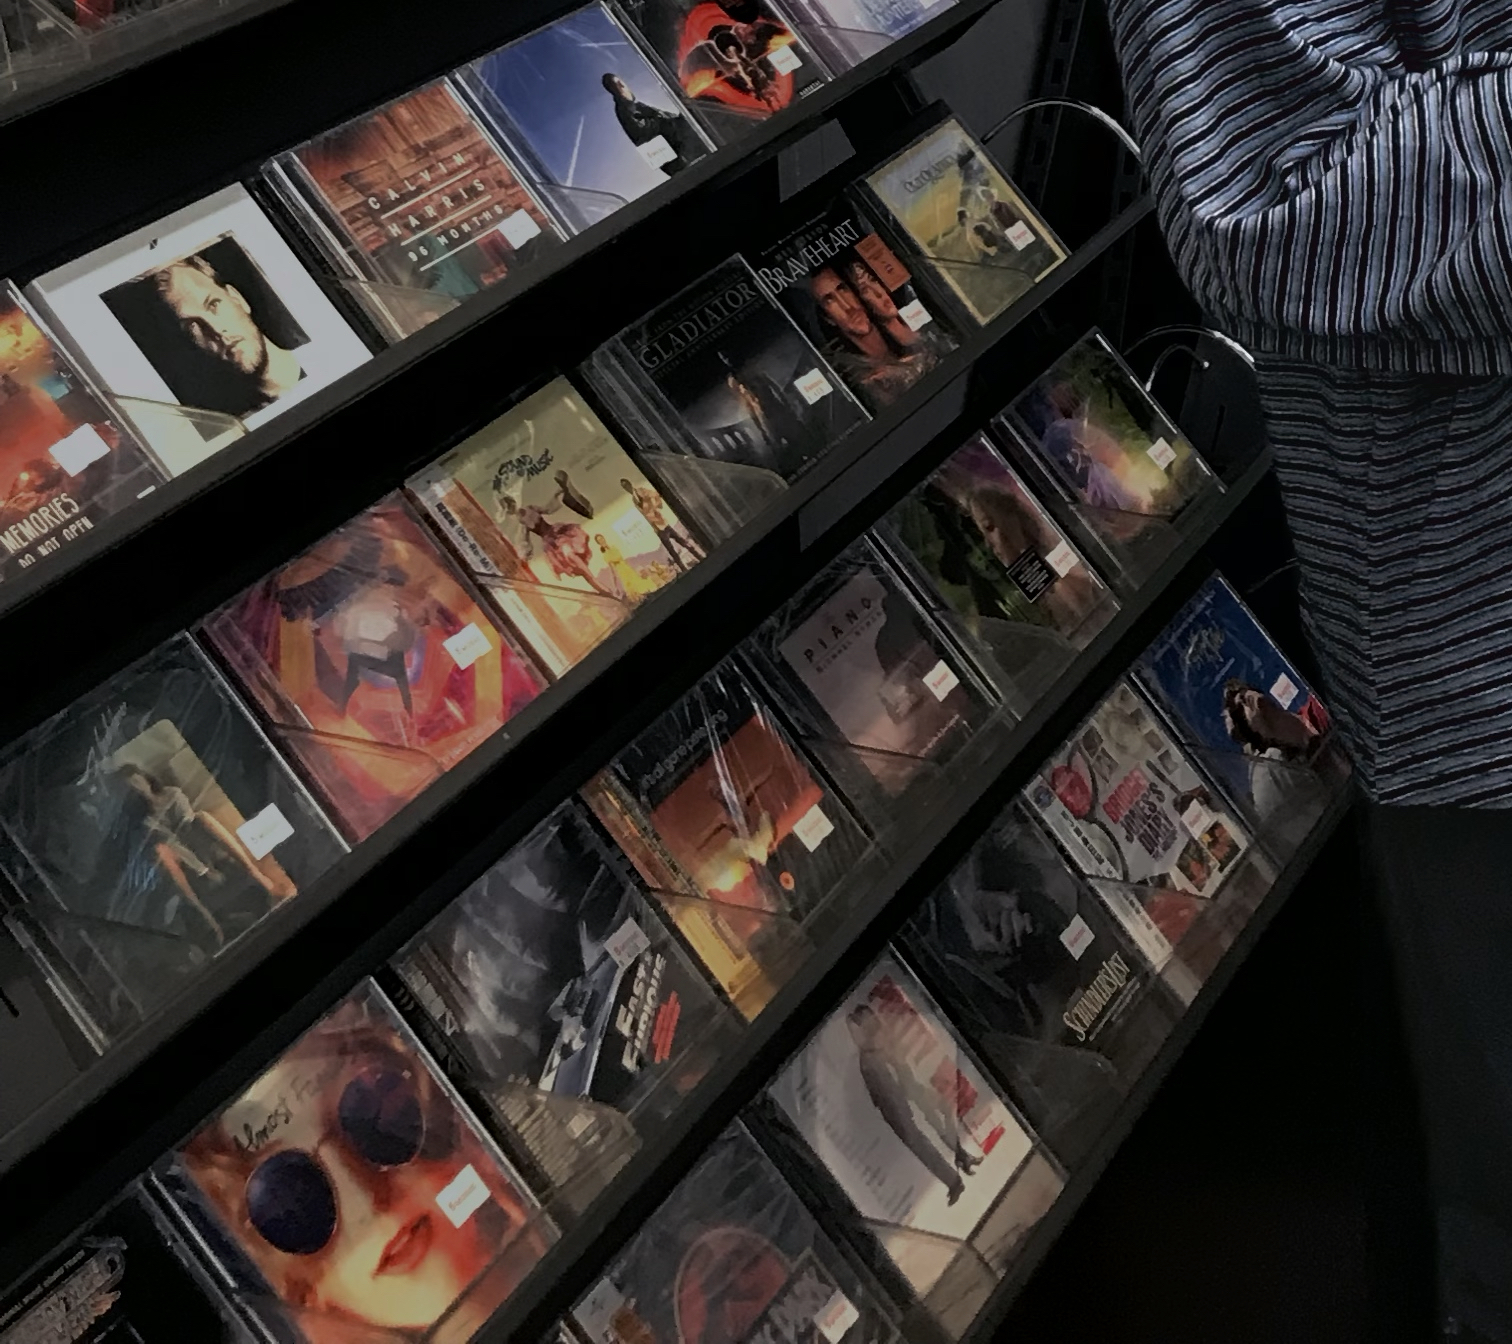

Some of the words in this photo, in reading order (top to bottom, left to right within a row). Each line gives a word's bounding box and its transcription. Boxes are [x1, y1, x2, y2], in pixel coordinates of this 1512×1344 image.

[366, 151, 466, 209] CALVIN
[387, 177, 485, 237] HARRIS
[408, 245, 428, 262] 96
[437, 203, 503, 246] MONTHS
[757, 218, 860, 295] BRAVEHEART
[637, 280, 757, 370] GLADIATOR
[0, 491, 80, 553] MEMORIES
[36, 536, 60, 556] NOT
[61, 515, 94, 541] OPEN
[802, 594, 874, 663] PIANO
